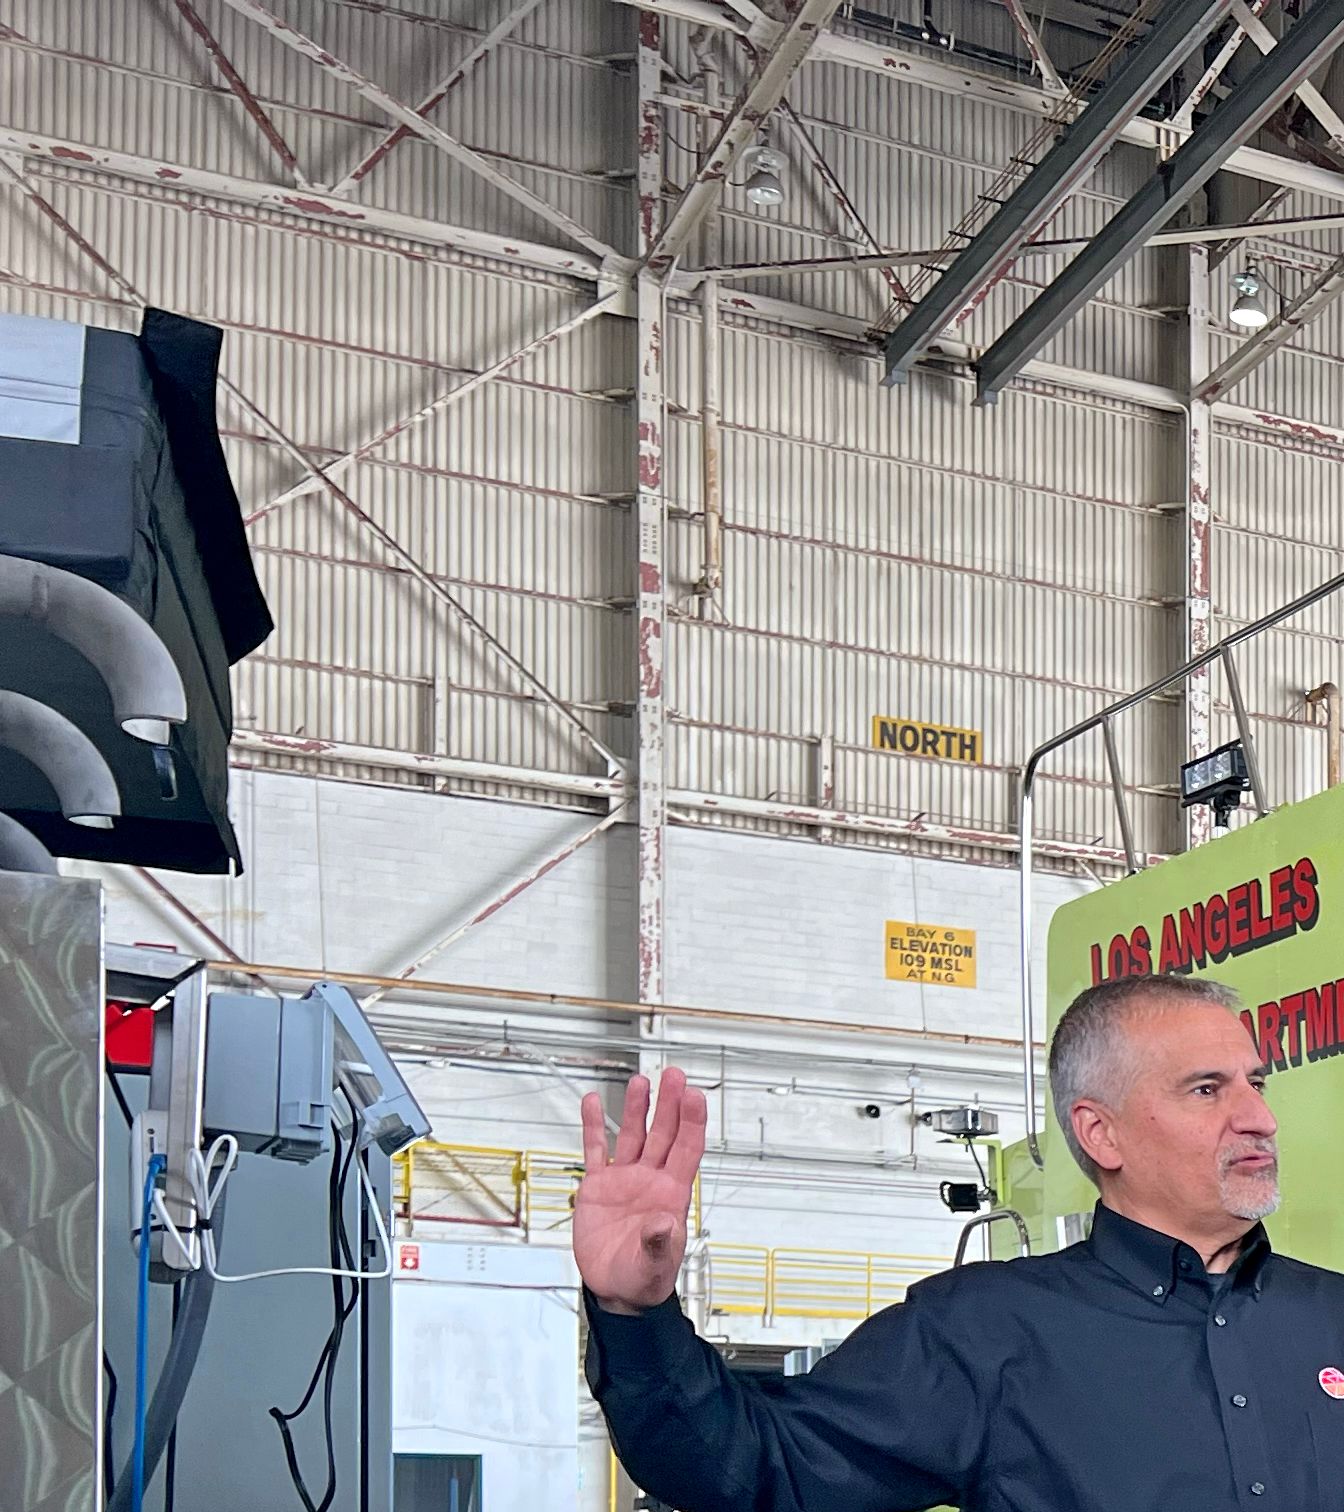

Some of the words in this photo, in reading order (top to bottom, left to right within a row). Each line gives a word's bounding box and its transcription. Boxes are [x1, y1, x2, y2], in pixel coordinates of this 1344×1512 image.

[880, 720, 977, 761] NORTH
[1090, 925, 1153, 988] LOS
[1158, 856, 1320, 976] ANGELES
[906, 926, 937, 939] BAY
[943, 931, 956, 942] 6
[889, 937, 973, 959] ELEVATION
[899, 952, 926, 968] 109
[930, 956, 964, 973] MSL
[906, 968, 927, 979] AT
